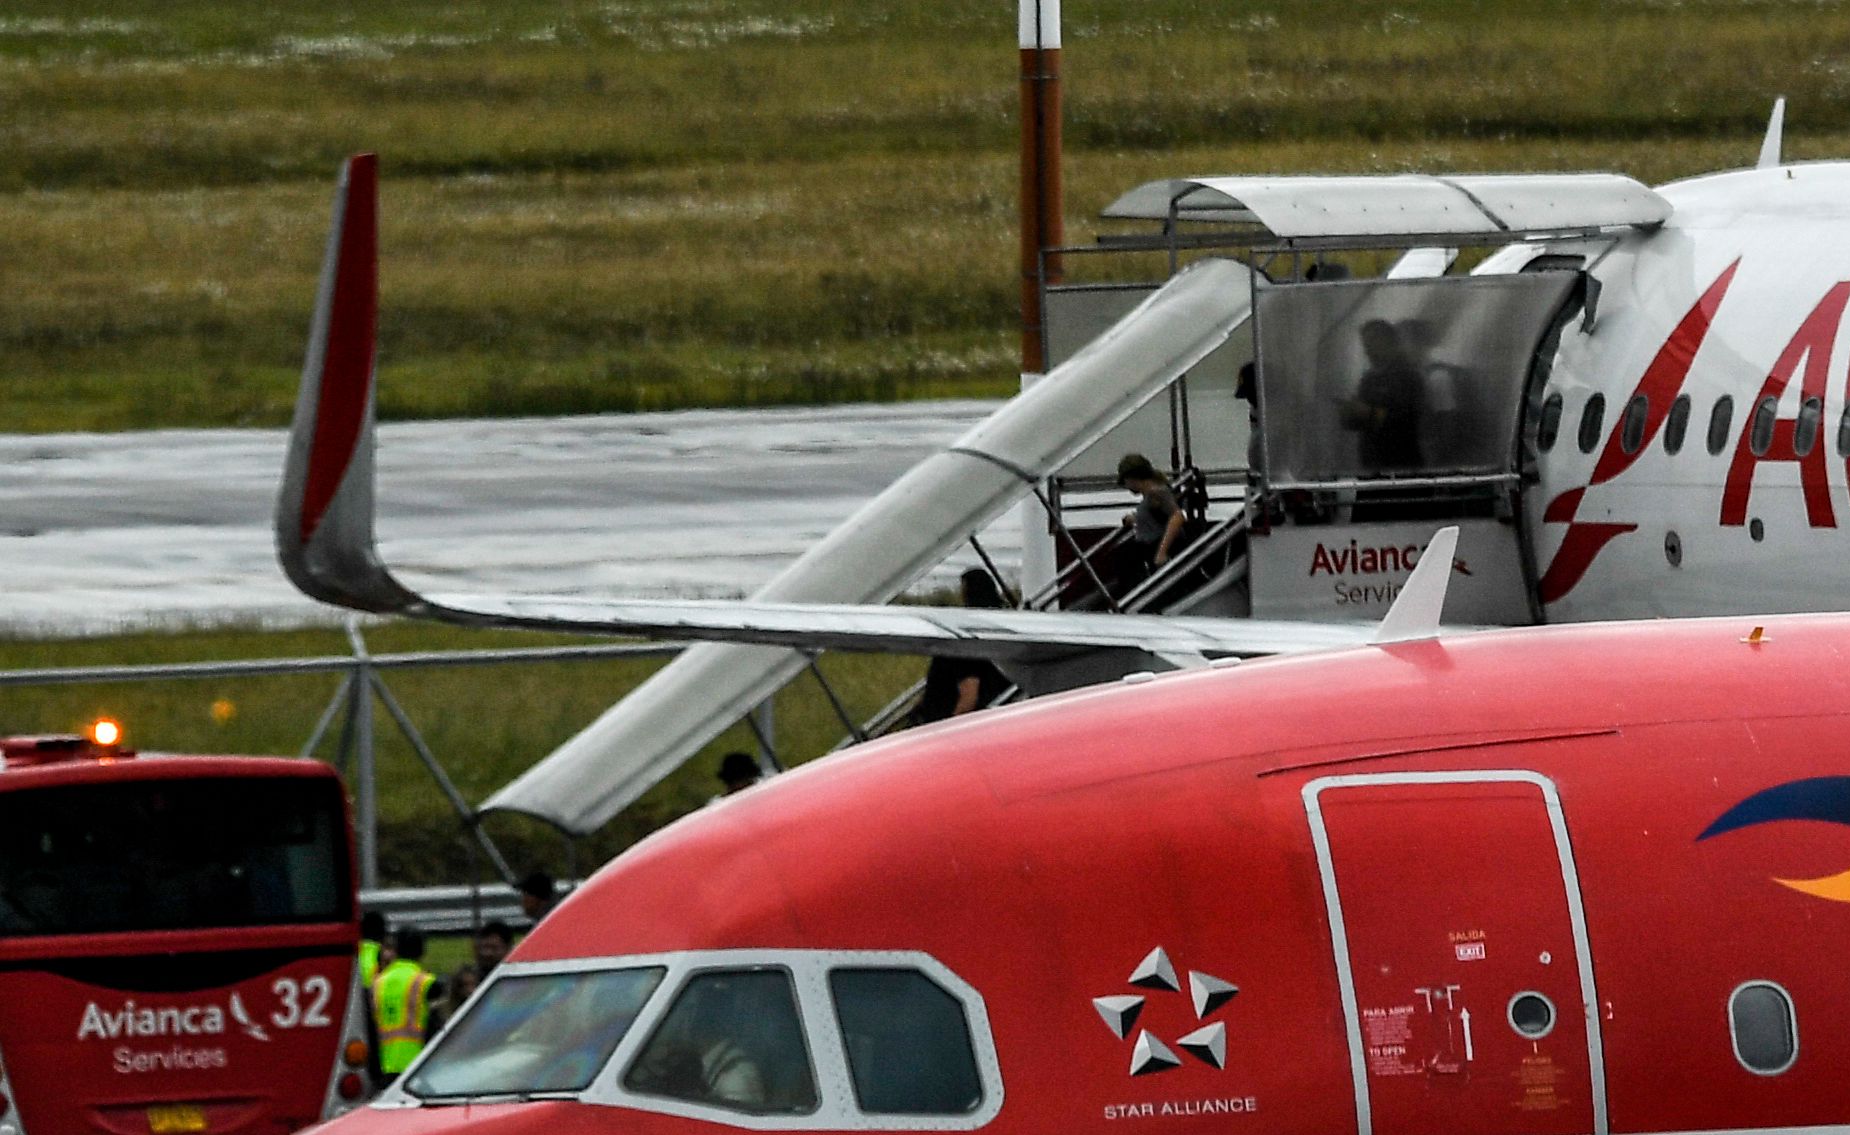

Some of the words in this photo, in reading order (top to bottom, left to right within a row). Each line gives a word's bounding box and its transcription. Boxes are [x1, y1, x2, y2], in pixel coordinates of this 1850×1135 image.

[1310, 538, 1430, 577] Avianc
[78, 1001, 224, 1040] Avianca
[271, 976, 332, 1028] 32
[113, 1047, 227, 1073] Services
[1104, 1102, 1154, 1120] STAR
[1160, 1097, 1257, 1116] ALLIANCE
